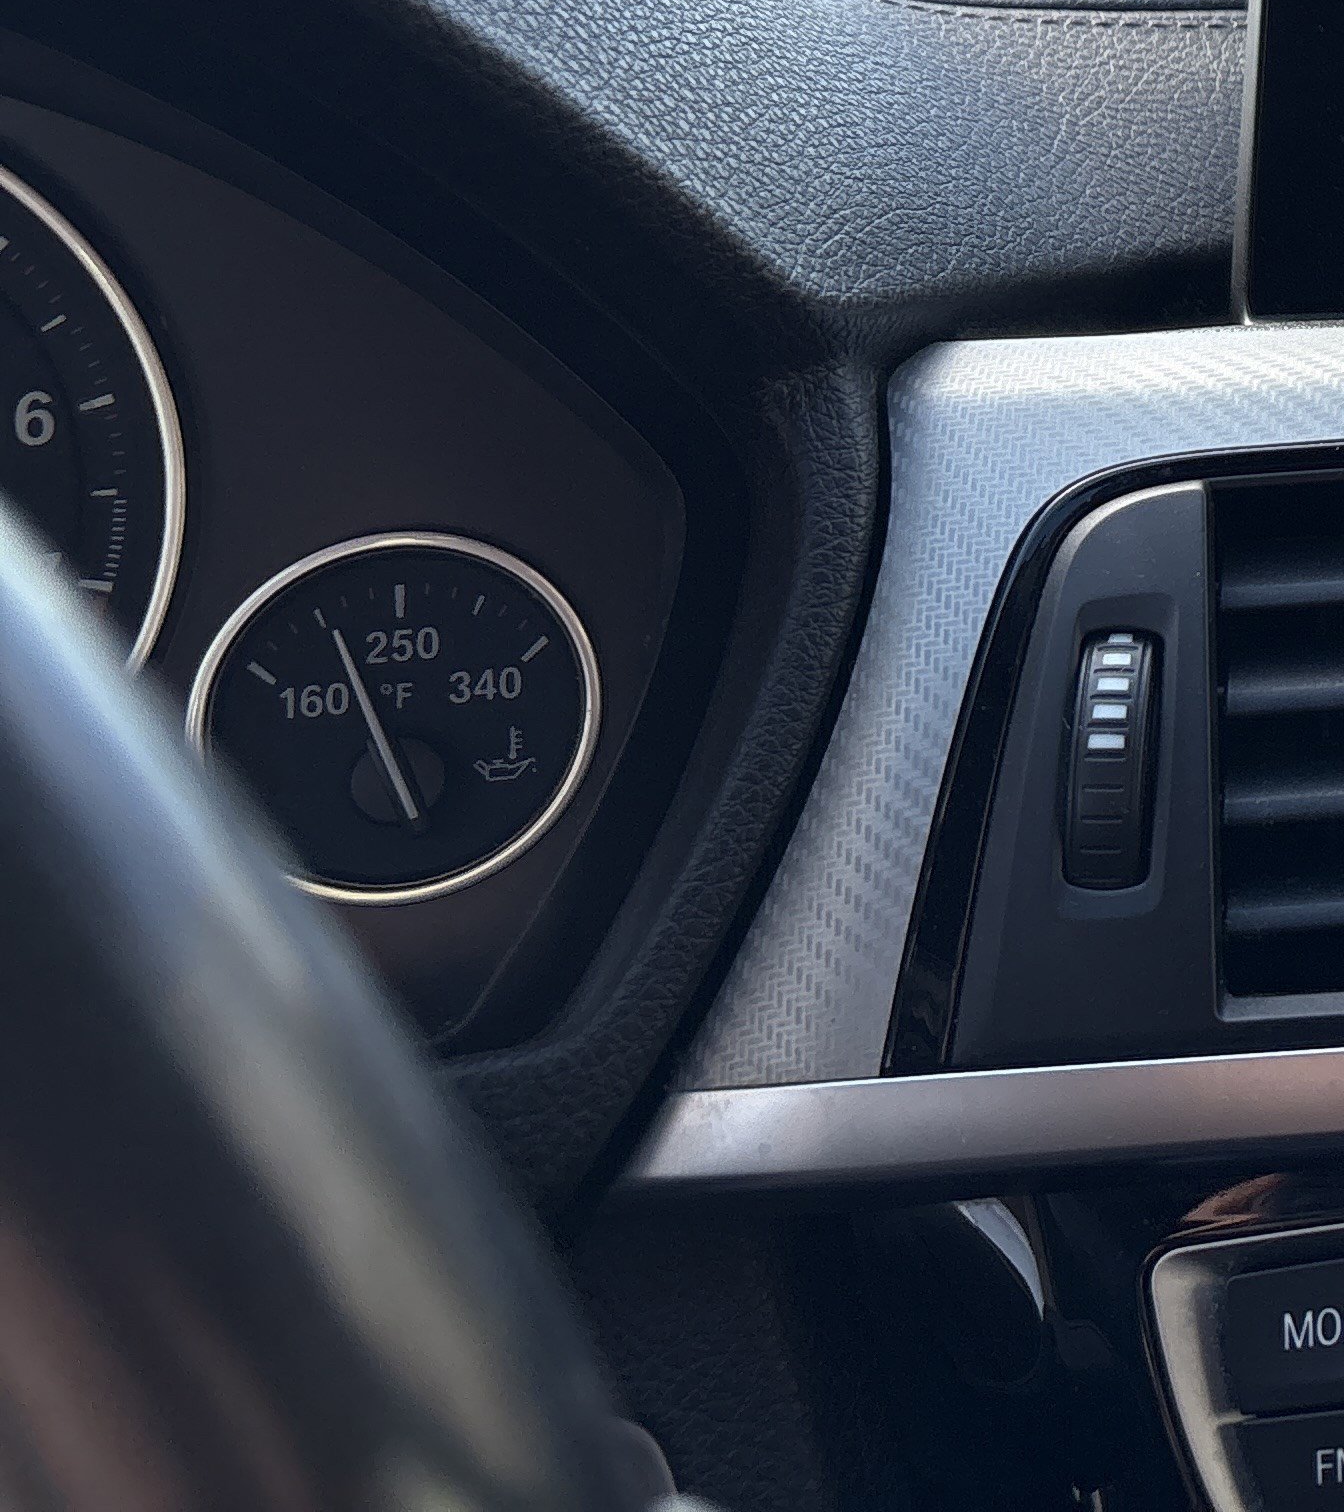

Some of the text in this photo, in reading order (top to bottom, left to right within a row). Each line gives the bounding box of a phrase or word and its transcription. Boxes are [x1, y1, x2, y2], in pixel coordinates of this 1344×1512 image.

[14, 390, 56, 447] 6
[366, 627, 440, 664] 250
[279, 683, 349, 719] 160
[449, 667, 522, 704] 340
